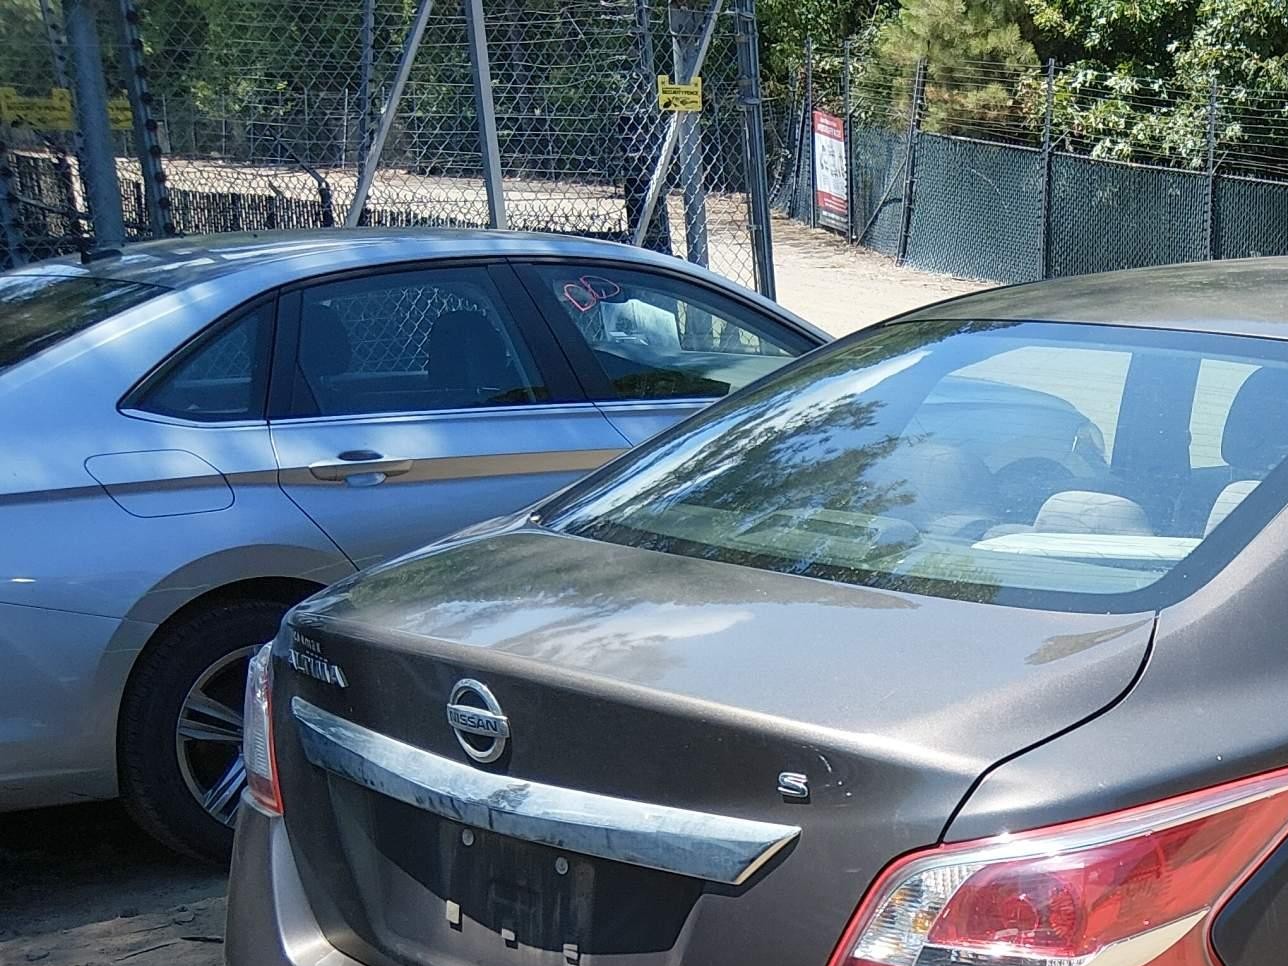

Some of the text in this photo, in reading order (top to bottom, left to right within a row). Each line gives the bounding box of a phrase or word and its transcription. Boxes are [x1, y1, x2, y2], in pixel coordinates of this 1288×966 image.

[288, 648, 350, 688] ALTIMA
[449, 711, 499, 732] NISSAN
[777, 771, 809, 798] S
